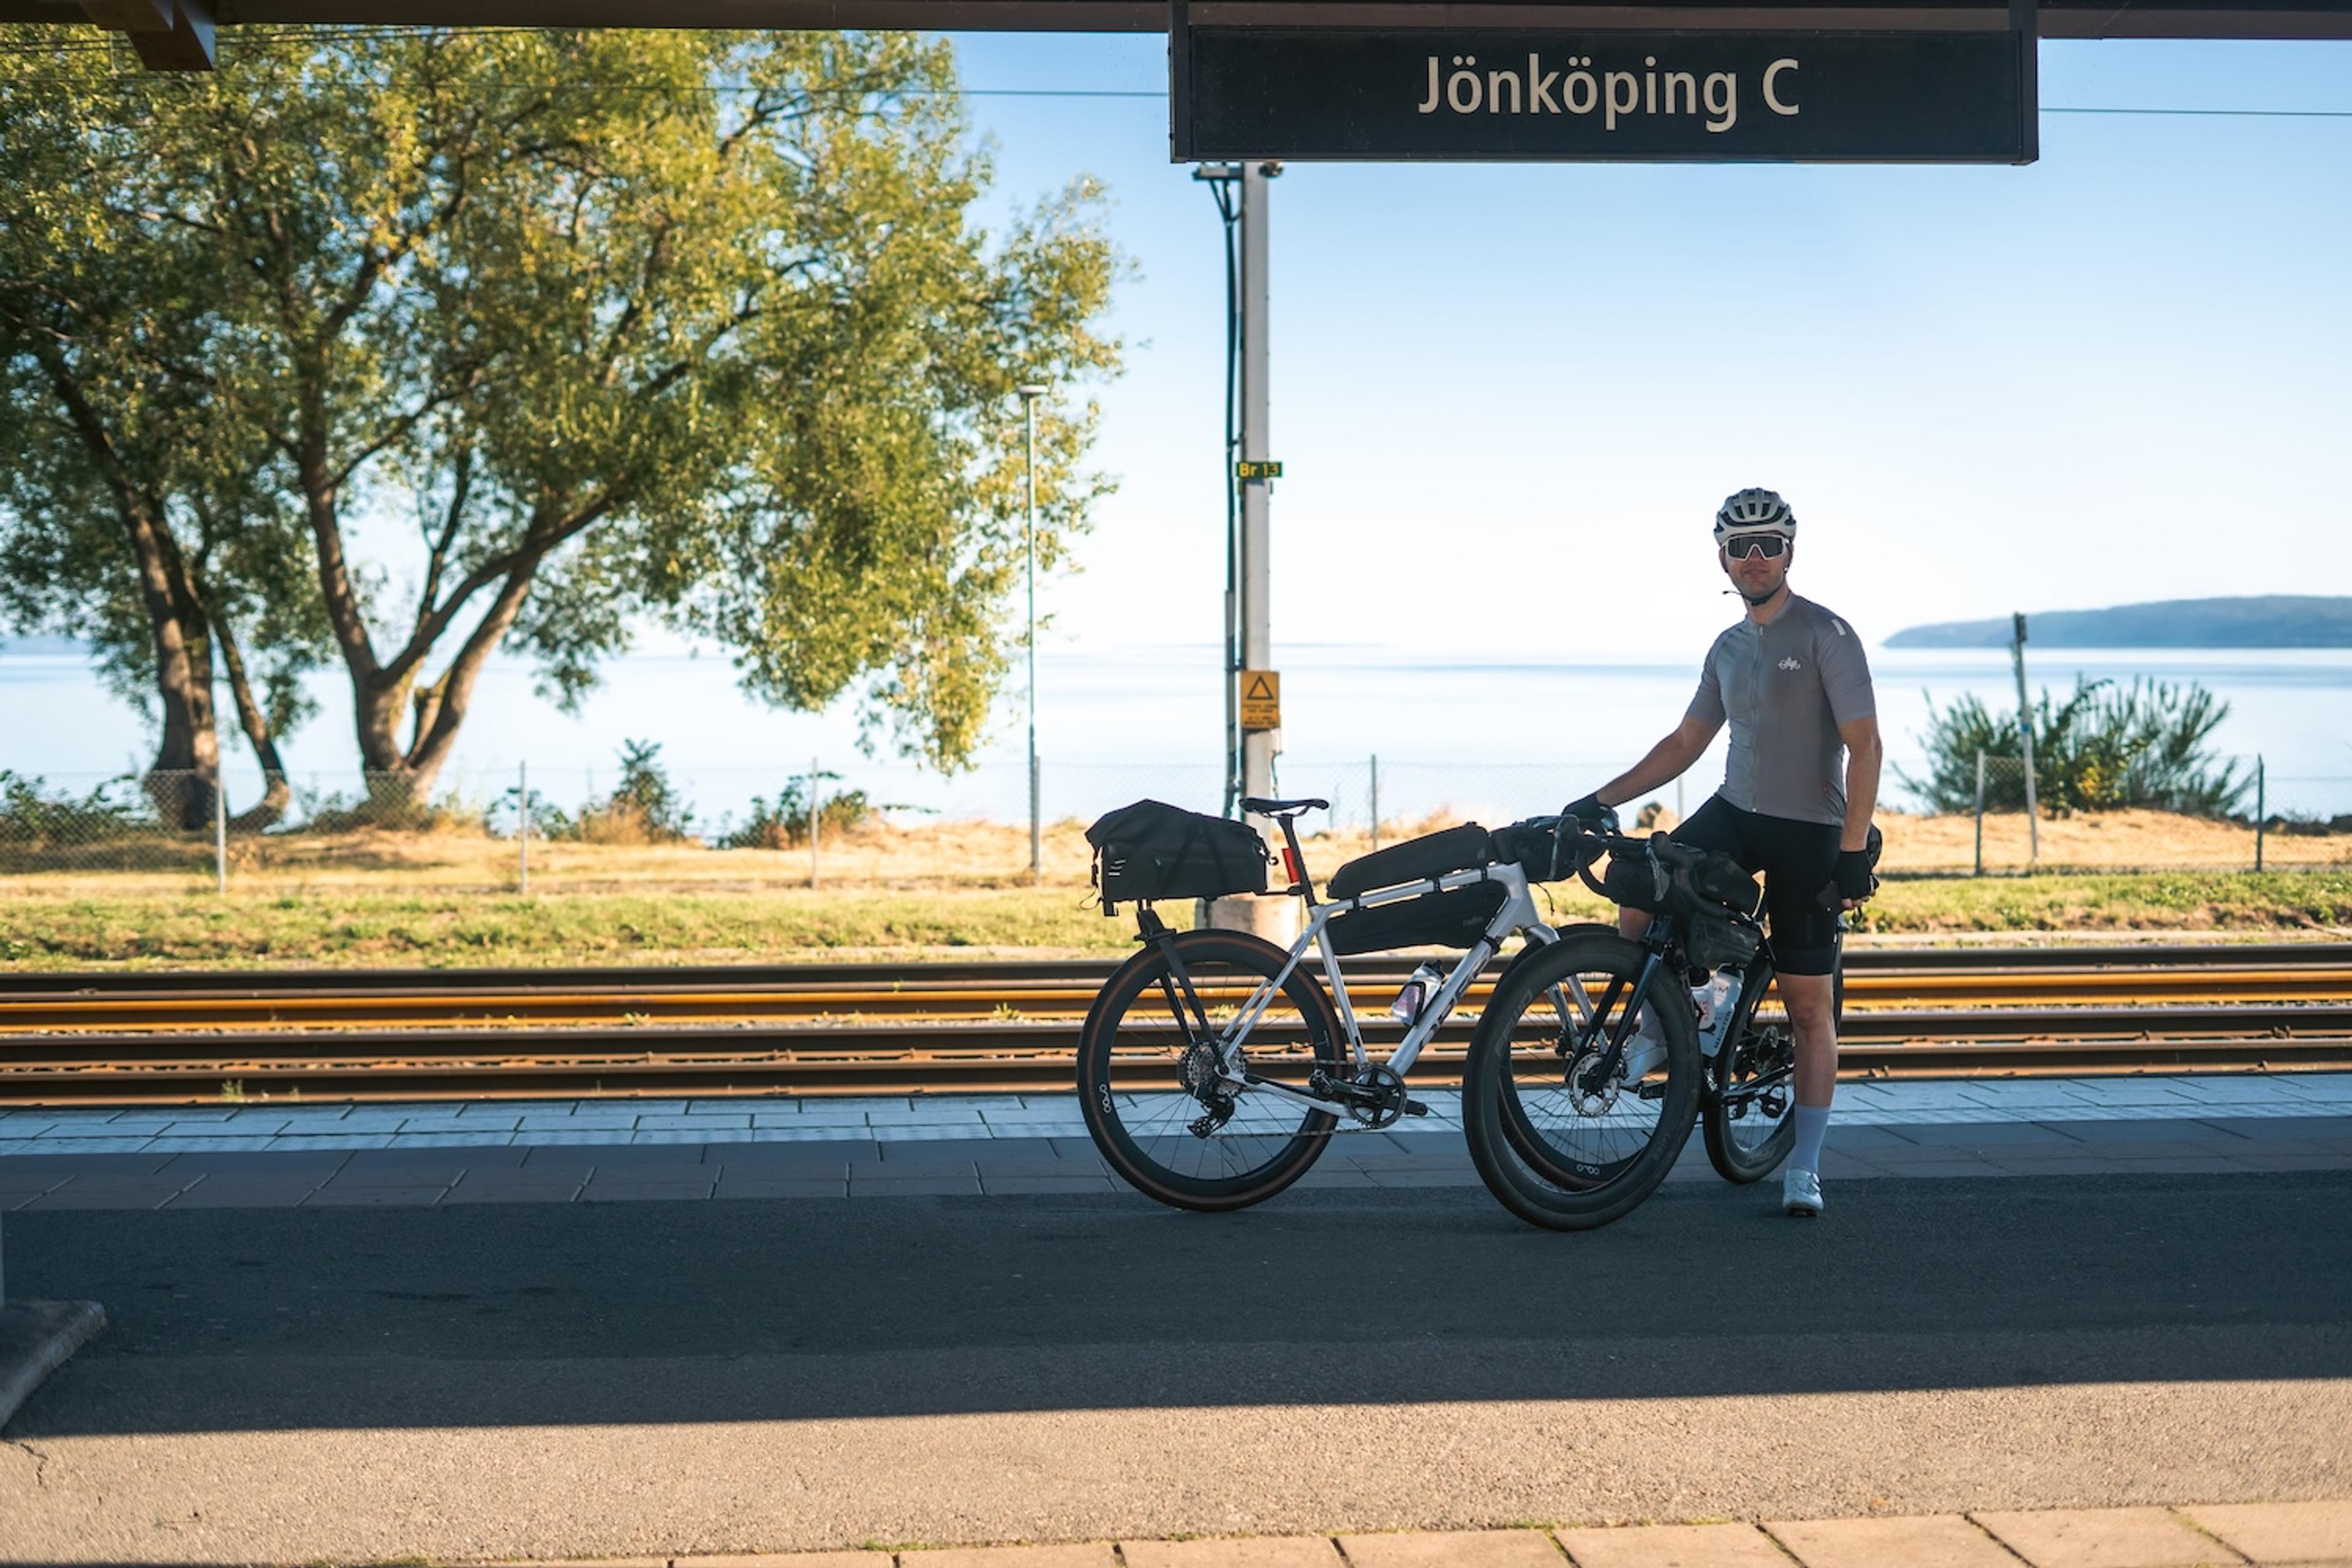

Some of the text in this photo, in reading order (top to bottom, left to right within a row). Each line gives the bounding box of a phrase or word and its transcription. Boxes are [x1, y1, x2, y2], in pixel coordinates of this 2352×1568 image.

[1419, 53, 1800, 132] Jönköping C
[1239, 462, 1279, 477] Br 13
